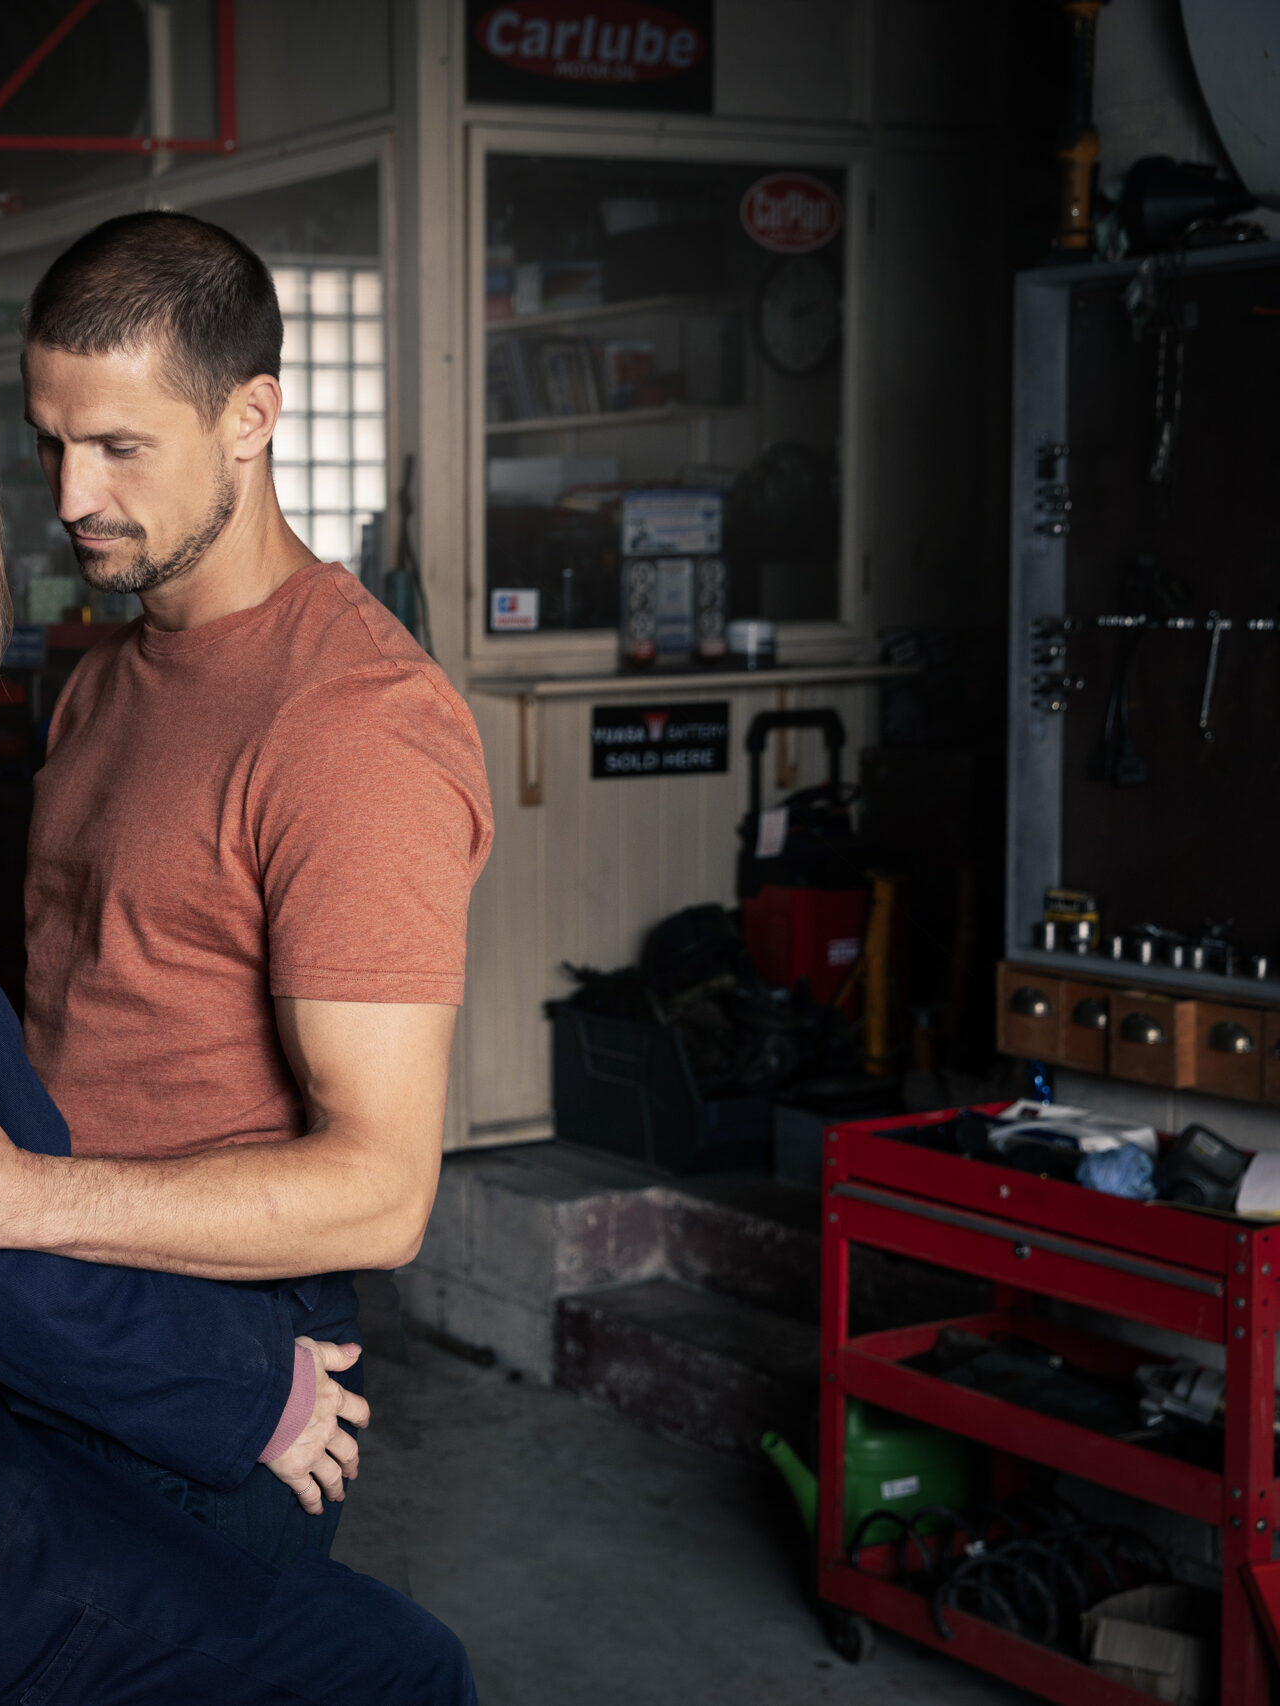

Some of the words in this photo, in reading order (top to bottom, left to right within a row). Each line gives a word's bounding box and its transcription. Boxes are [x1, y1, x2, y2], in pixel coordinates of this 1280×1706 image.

[485, 9, 698, 68] Carlube
[604, 750, 660, 772] SOLD
[662, 747, 717, 769] HERE
